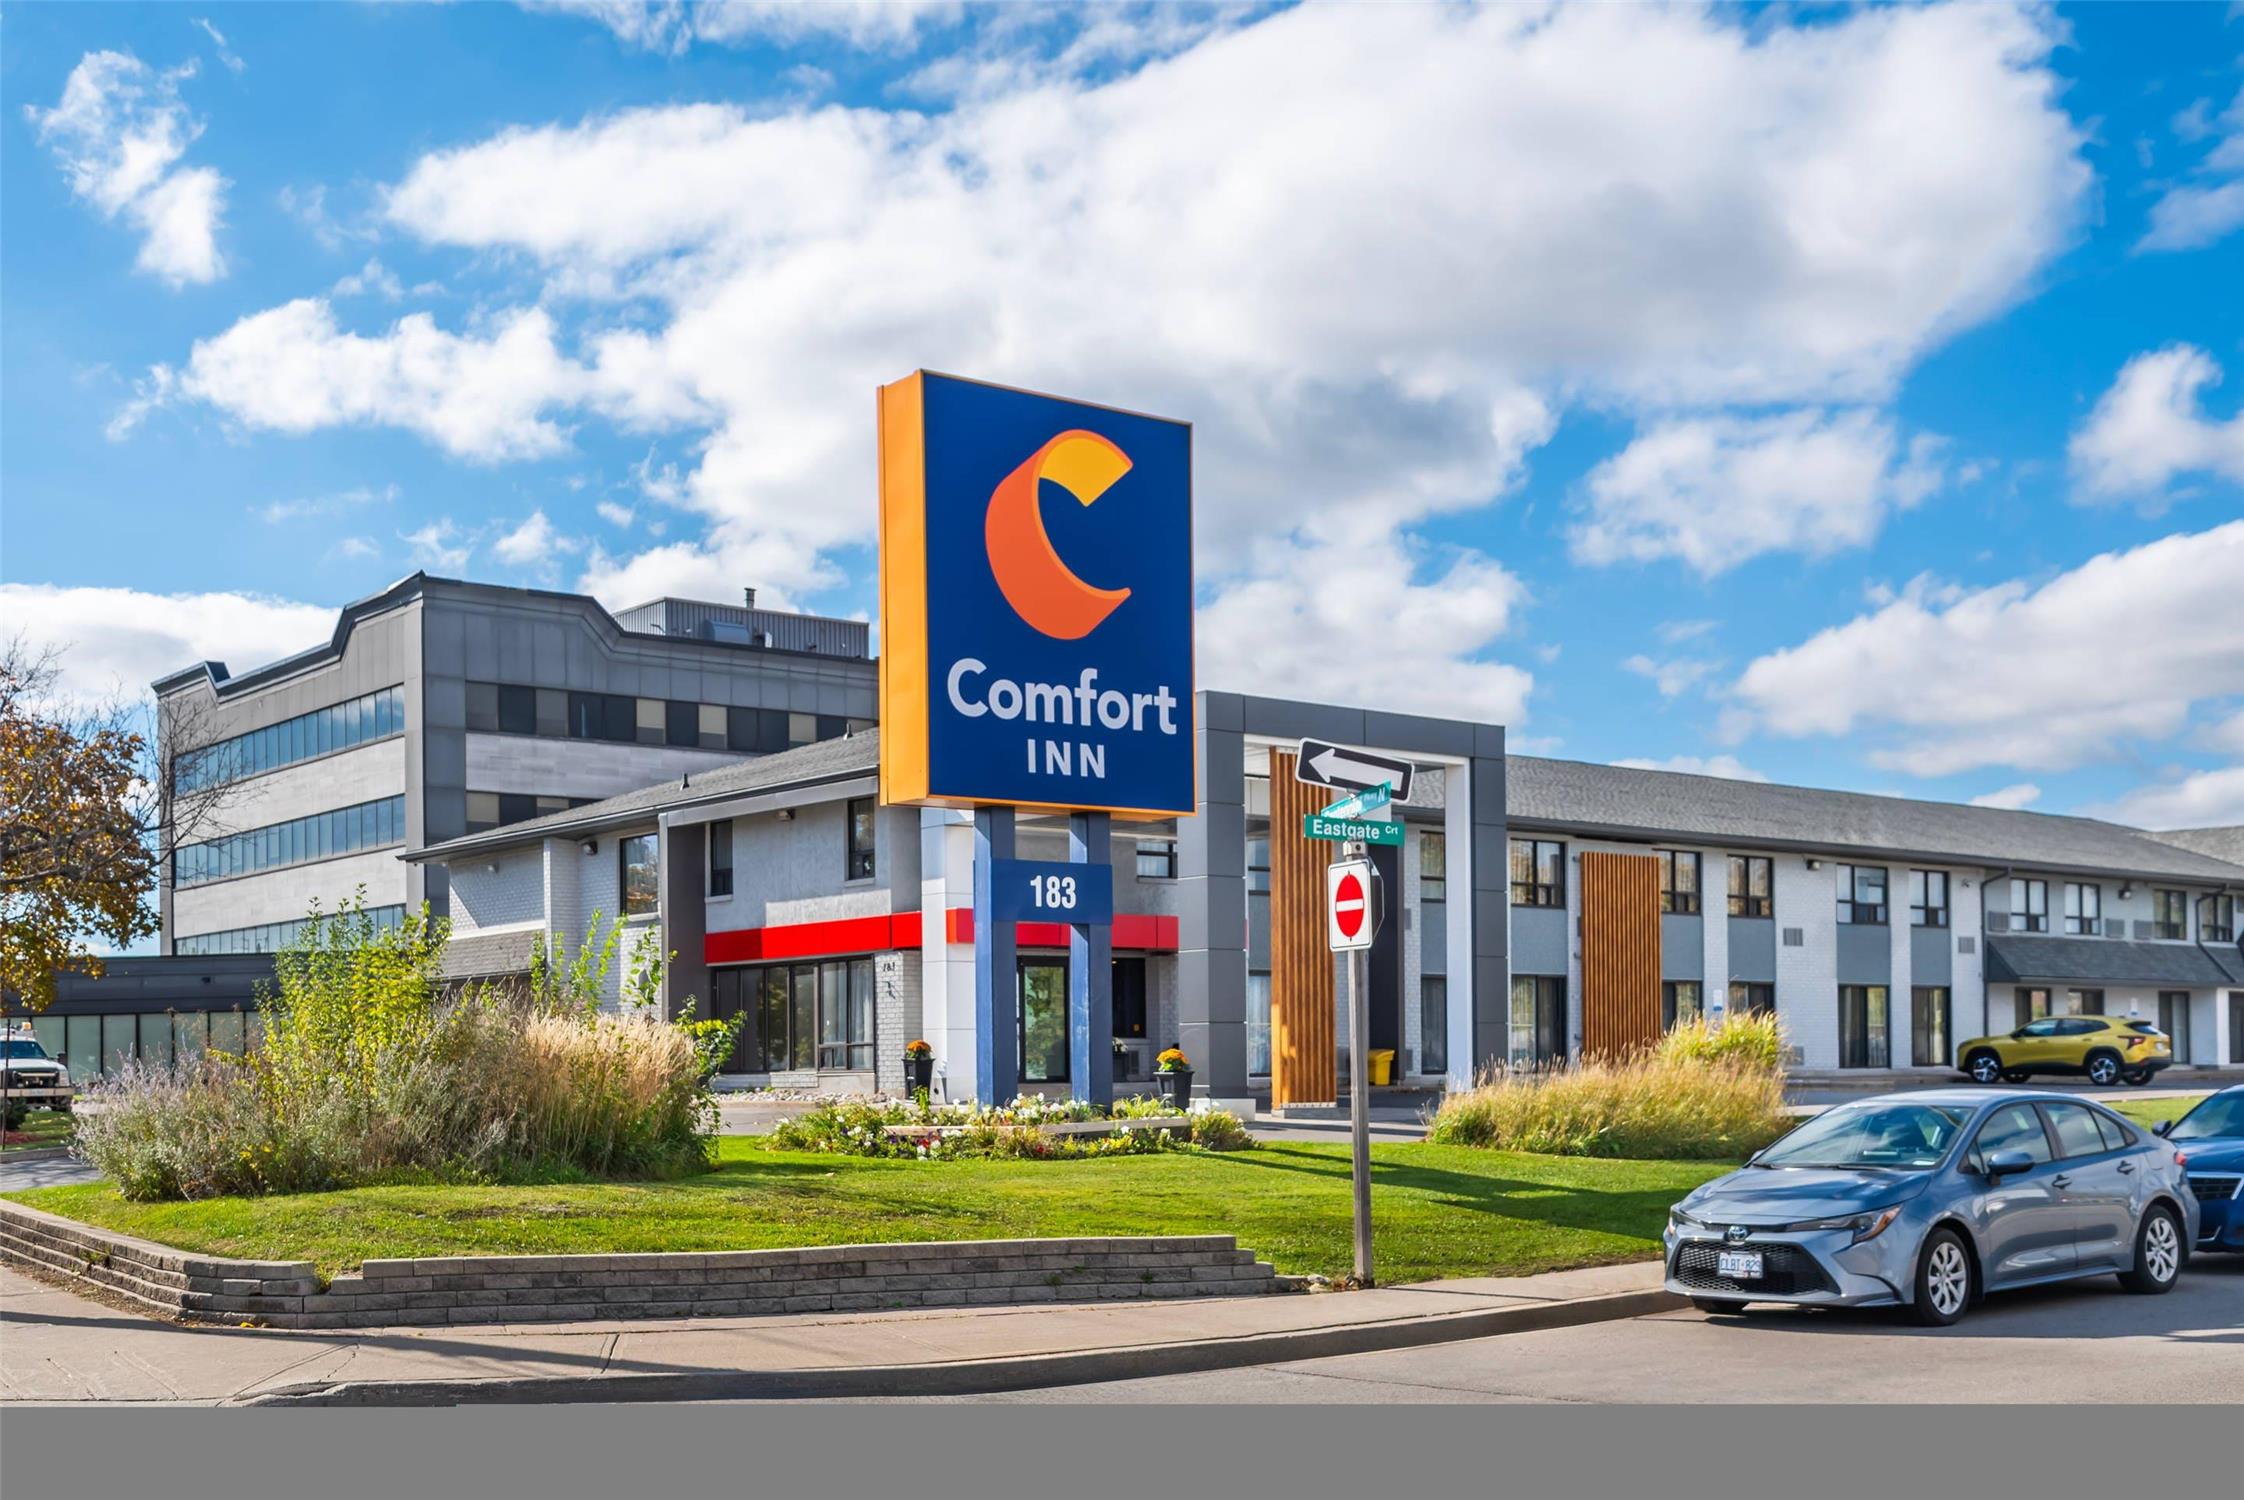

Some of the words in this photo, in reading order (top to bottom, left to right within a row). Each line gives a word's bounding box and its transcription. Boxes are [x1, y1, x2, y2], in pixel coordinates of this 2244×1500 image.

[947, 657, 1177, 735] Comfort
[1027, 738, 1105, 779] INN
[1312, 819, 1380, 840] Eastgate
[1384, 825, 1399, 836] Crt
[1030, 875, 1077, 909] 183
